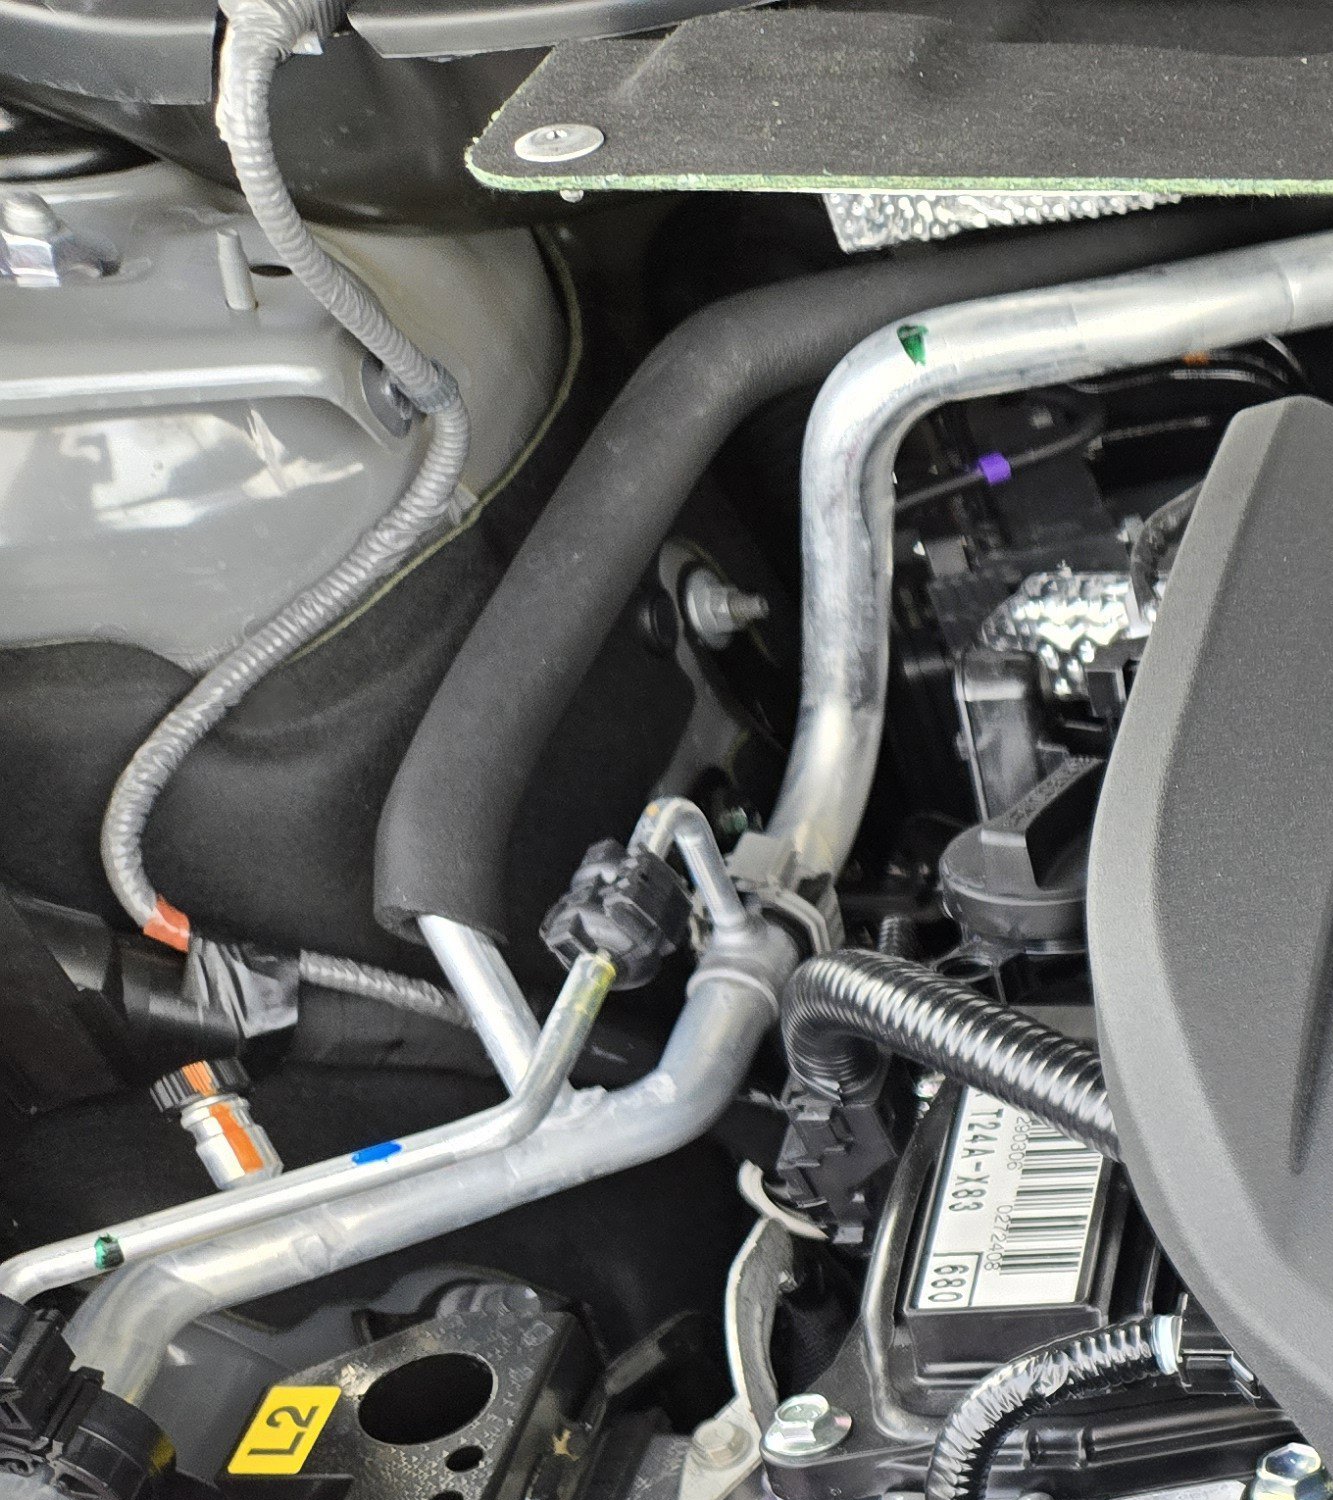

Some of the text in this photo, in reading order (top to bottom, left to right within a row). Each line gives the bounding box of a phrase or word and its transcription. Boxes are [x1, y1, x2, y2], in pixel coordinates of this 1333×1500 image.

[928, 1108, 1004, 1302] T24A-X83 680
[984, 1116, 1031, 1272] 290306 0272408
[247, 1405, 320, 1456] L2
